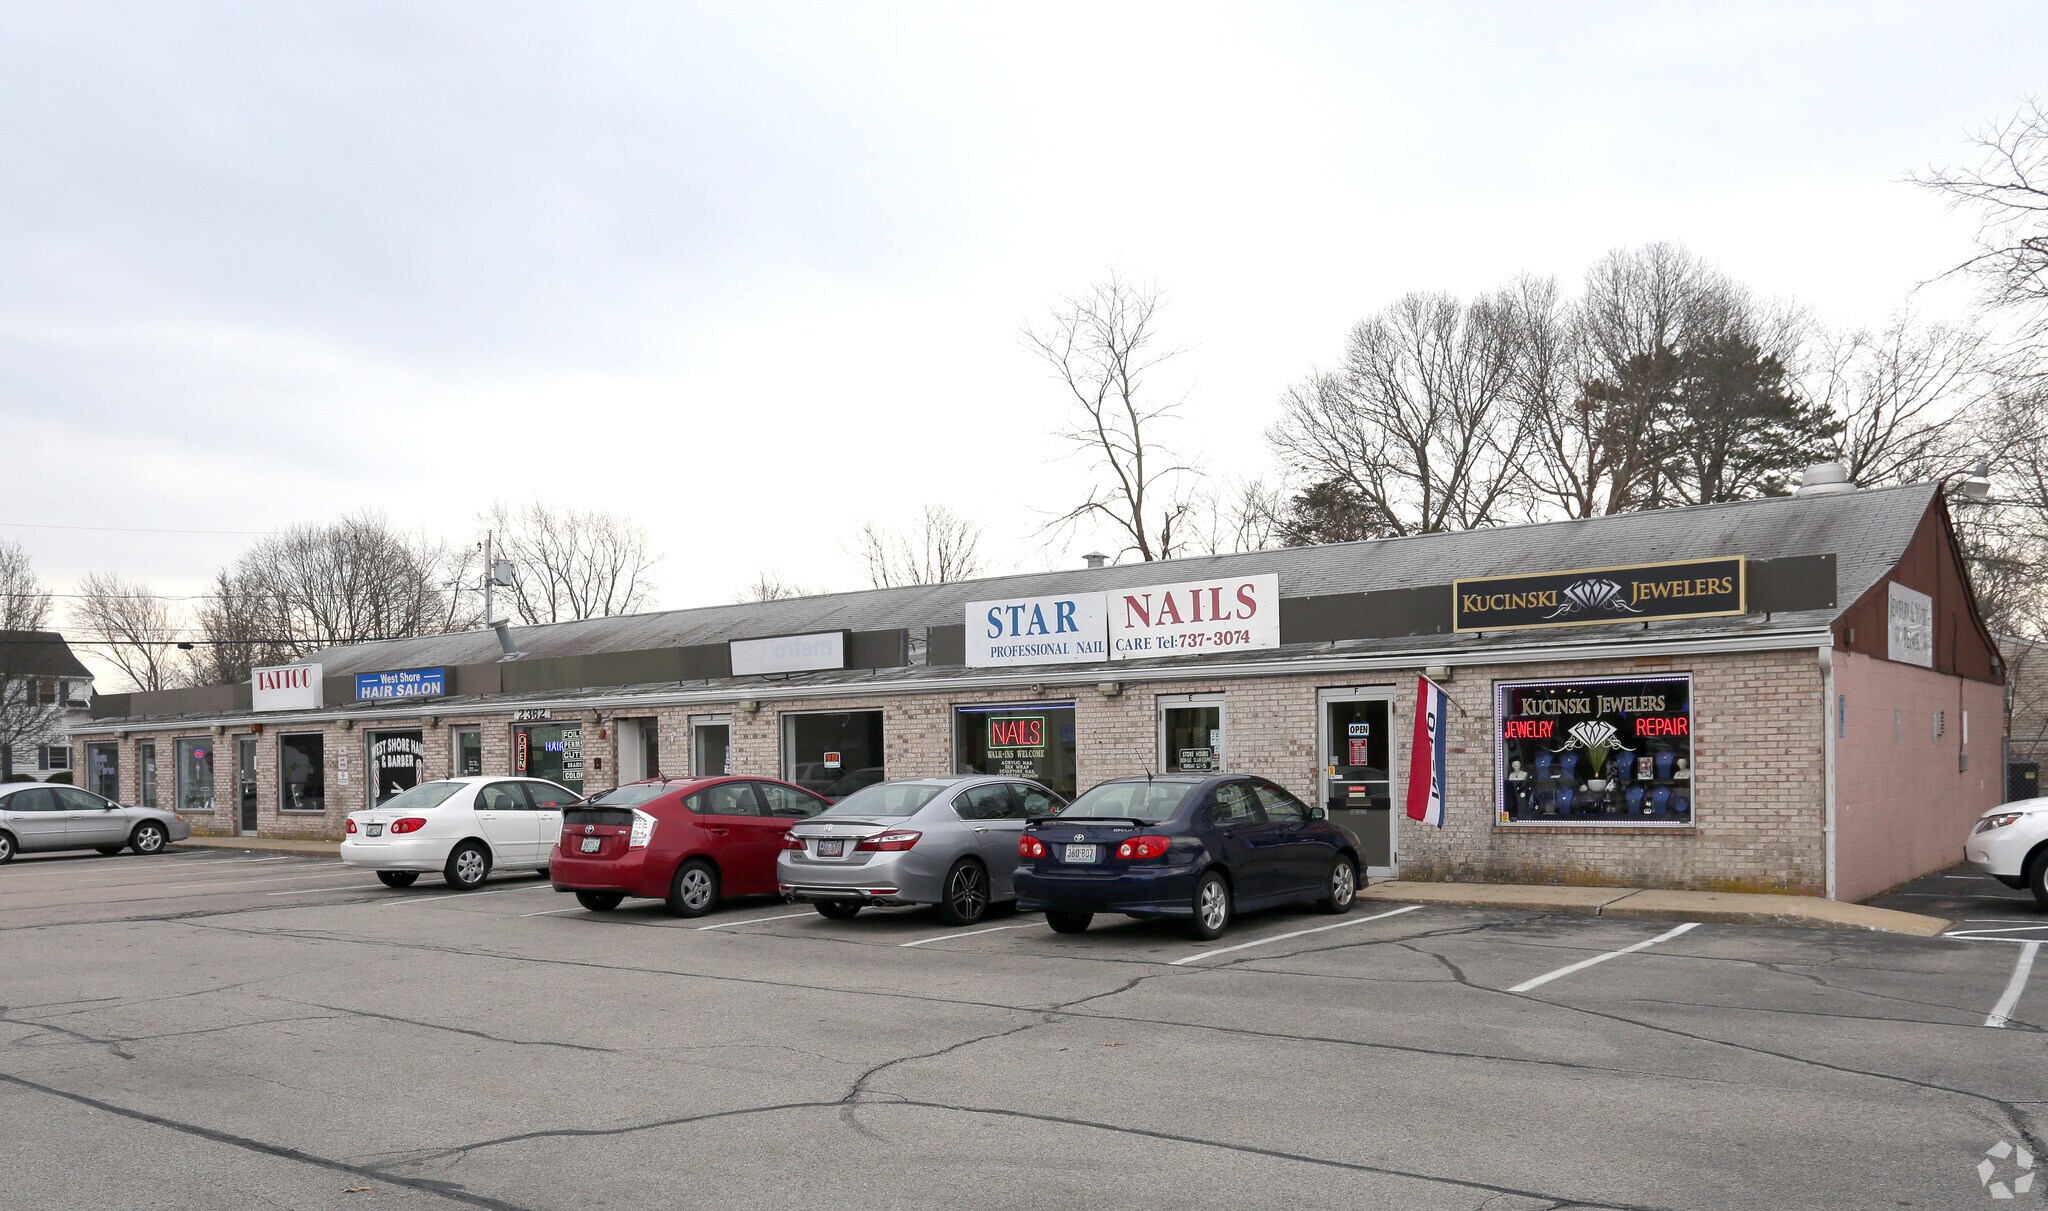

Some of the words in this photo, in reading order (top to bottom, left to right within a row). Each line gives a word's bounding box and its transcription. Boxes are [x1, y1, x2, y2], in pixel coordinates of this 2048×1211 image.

[1123, 583, 1257, 629] NAILS
[1462, 590, 1558, 613] KUCINSKI
[1630, 577, 1733, 606] JEWELERS
[987, 600, 1079, 639] STAR
[990, 642, 1069, 658] PROFESSIONAL
[1076, 640, 1105, 654] NAIL
[1115, 636, 1152, 651] CARE
[1178, 629, 1250, 648] 737-3074
[256, 667, 312, 690] TATTOO
[380, 673, 398, 684] West
[400, 672, 421, 683] Shore
[361, 685, 393, 699] HAIR
[396, 681, 441, 696] SALON
[1188, 694, 1193, 702] E
[518, 708, 545, 720] 2362
[1521, 697, 1591, 716] KUCINSKI
[1596, 694, 1666, 718] JEWELERS
[992, 720, 1041, 745] NAILS
[1350, 725, 1368, 734] OPEN
[1504, 720, 1554, 739] JEWELRY
[1636, 717, 1688, 736] REPAIR
[371, 740, 386, 759] WEST
[387, 737, 410, 753] SHORE
[545, 741, 565, 752] HAIR
[987, 750, 1014, 759] WALK-INS
[1017, 749, 1044, 758] WELCOME
[381, 755, 387, 768] &
[387, 754, 414, 768] BARBER
